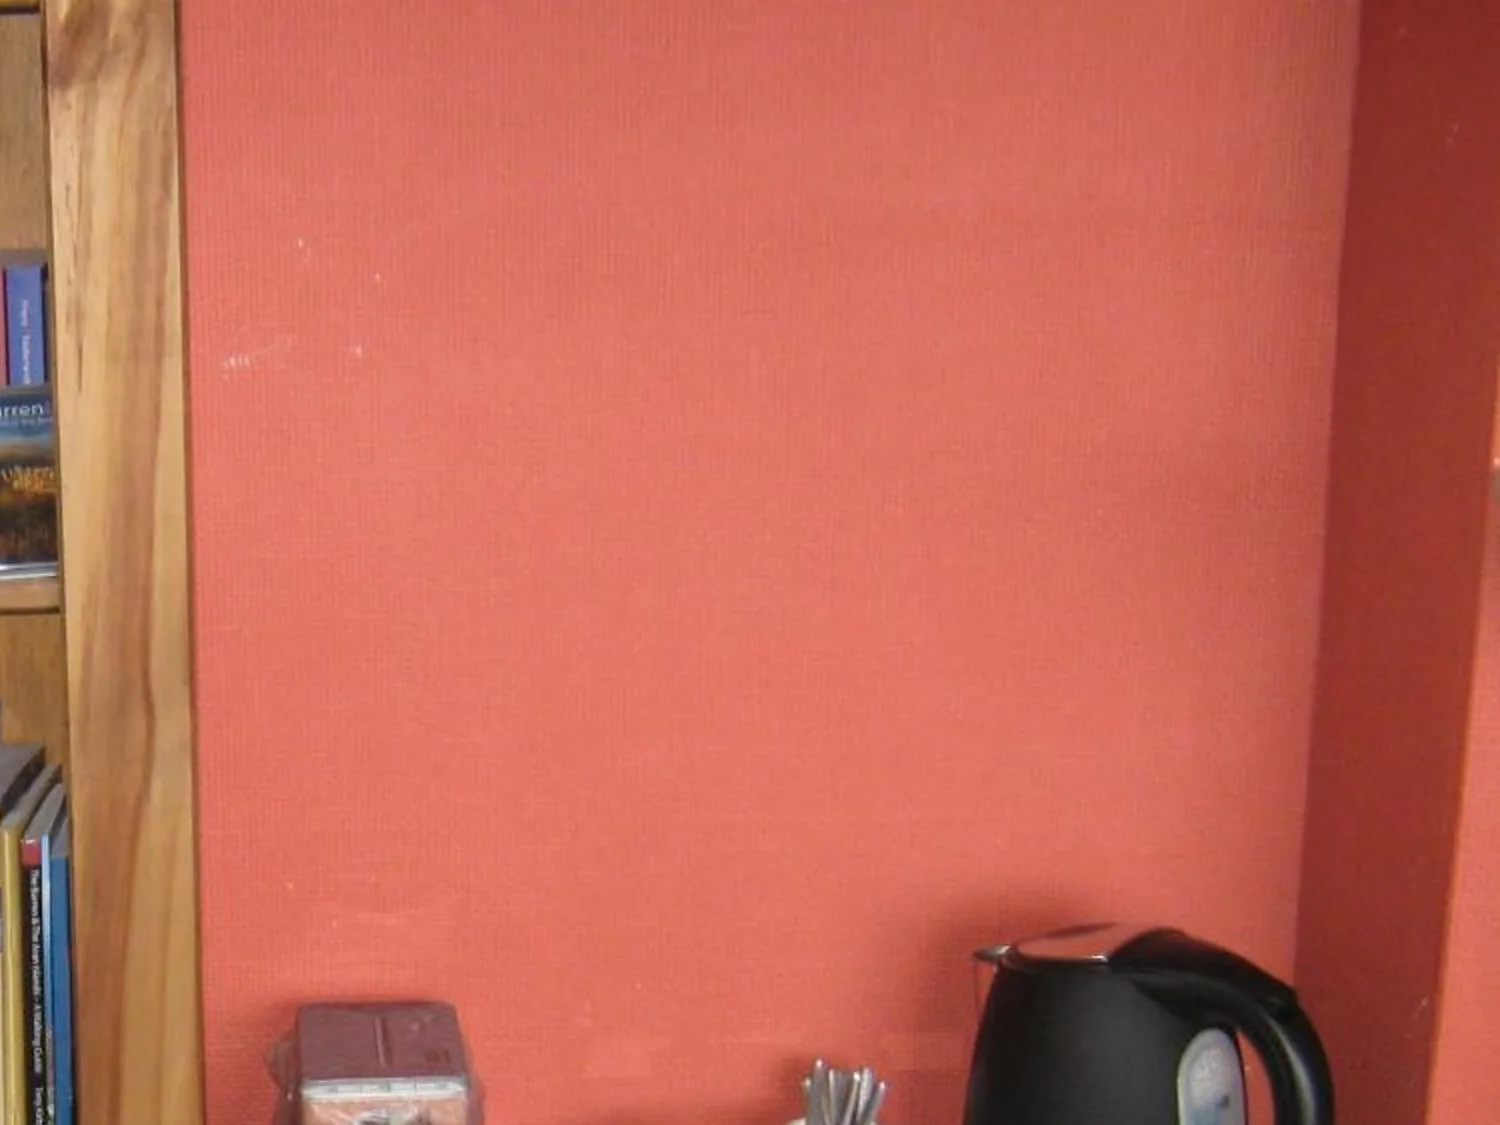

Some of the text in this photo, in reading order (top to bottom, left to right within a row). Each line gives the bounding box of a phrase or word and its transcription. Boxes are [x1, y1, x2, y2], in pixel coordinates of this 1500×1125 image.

[30, 869, 40, 886] The
[30, 887, 40, 917] Burren
[31, 925, 40, 942] The
